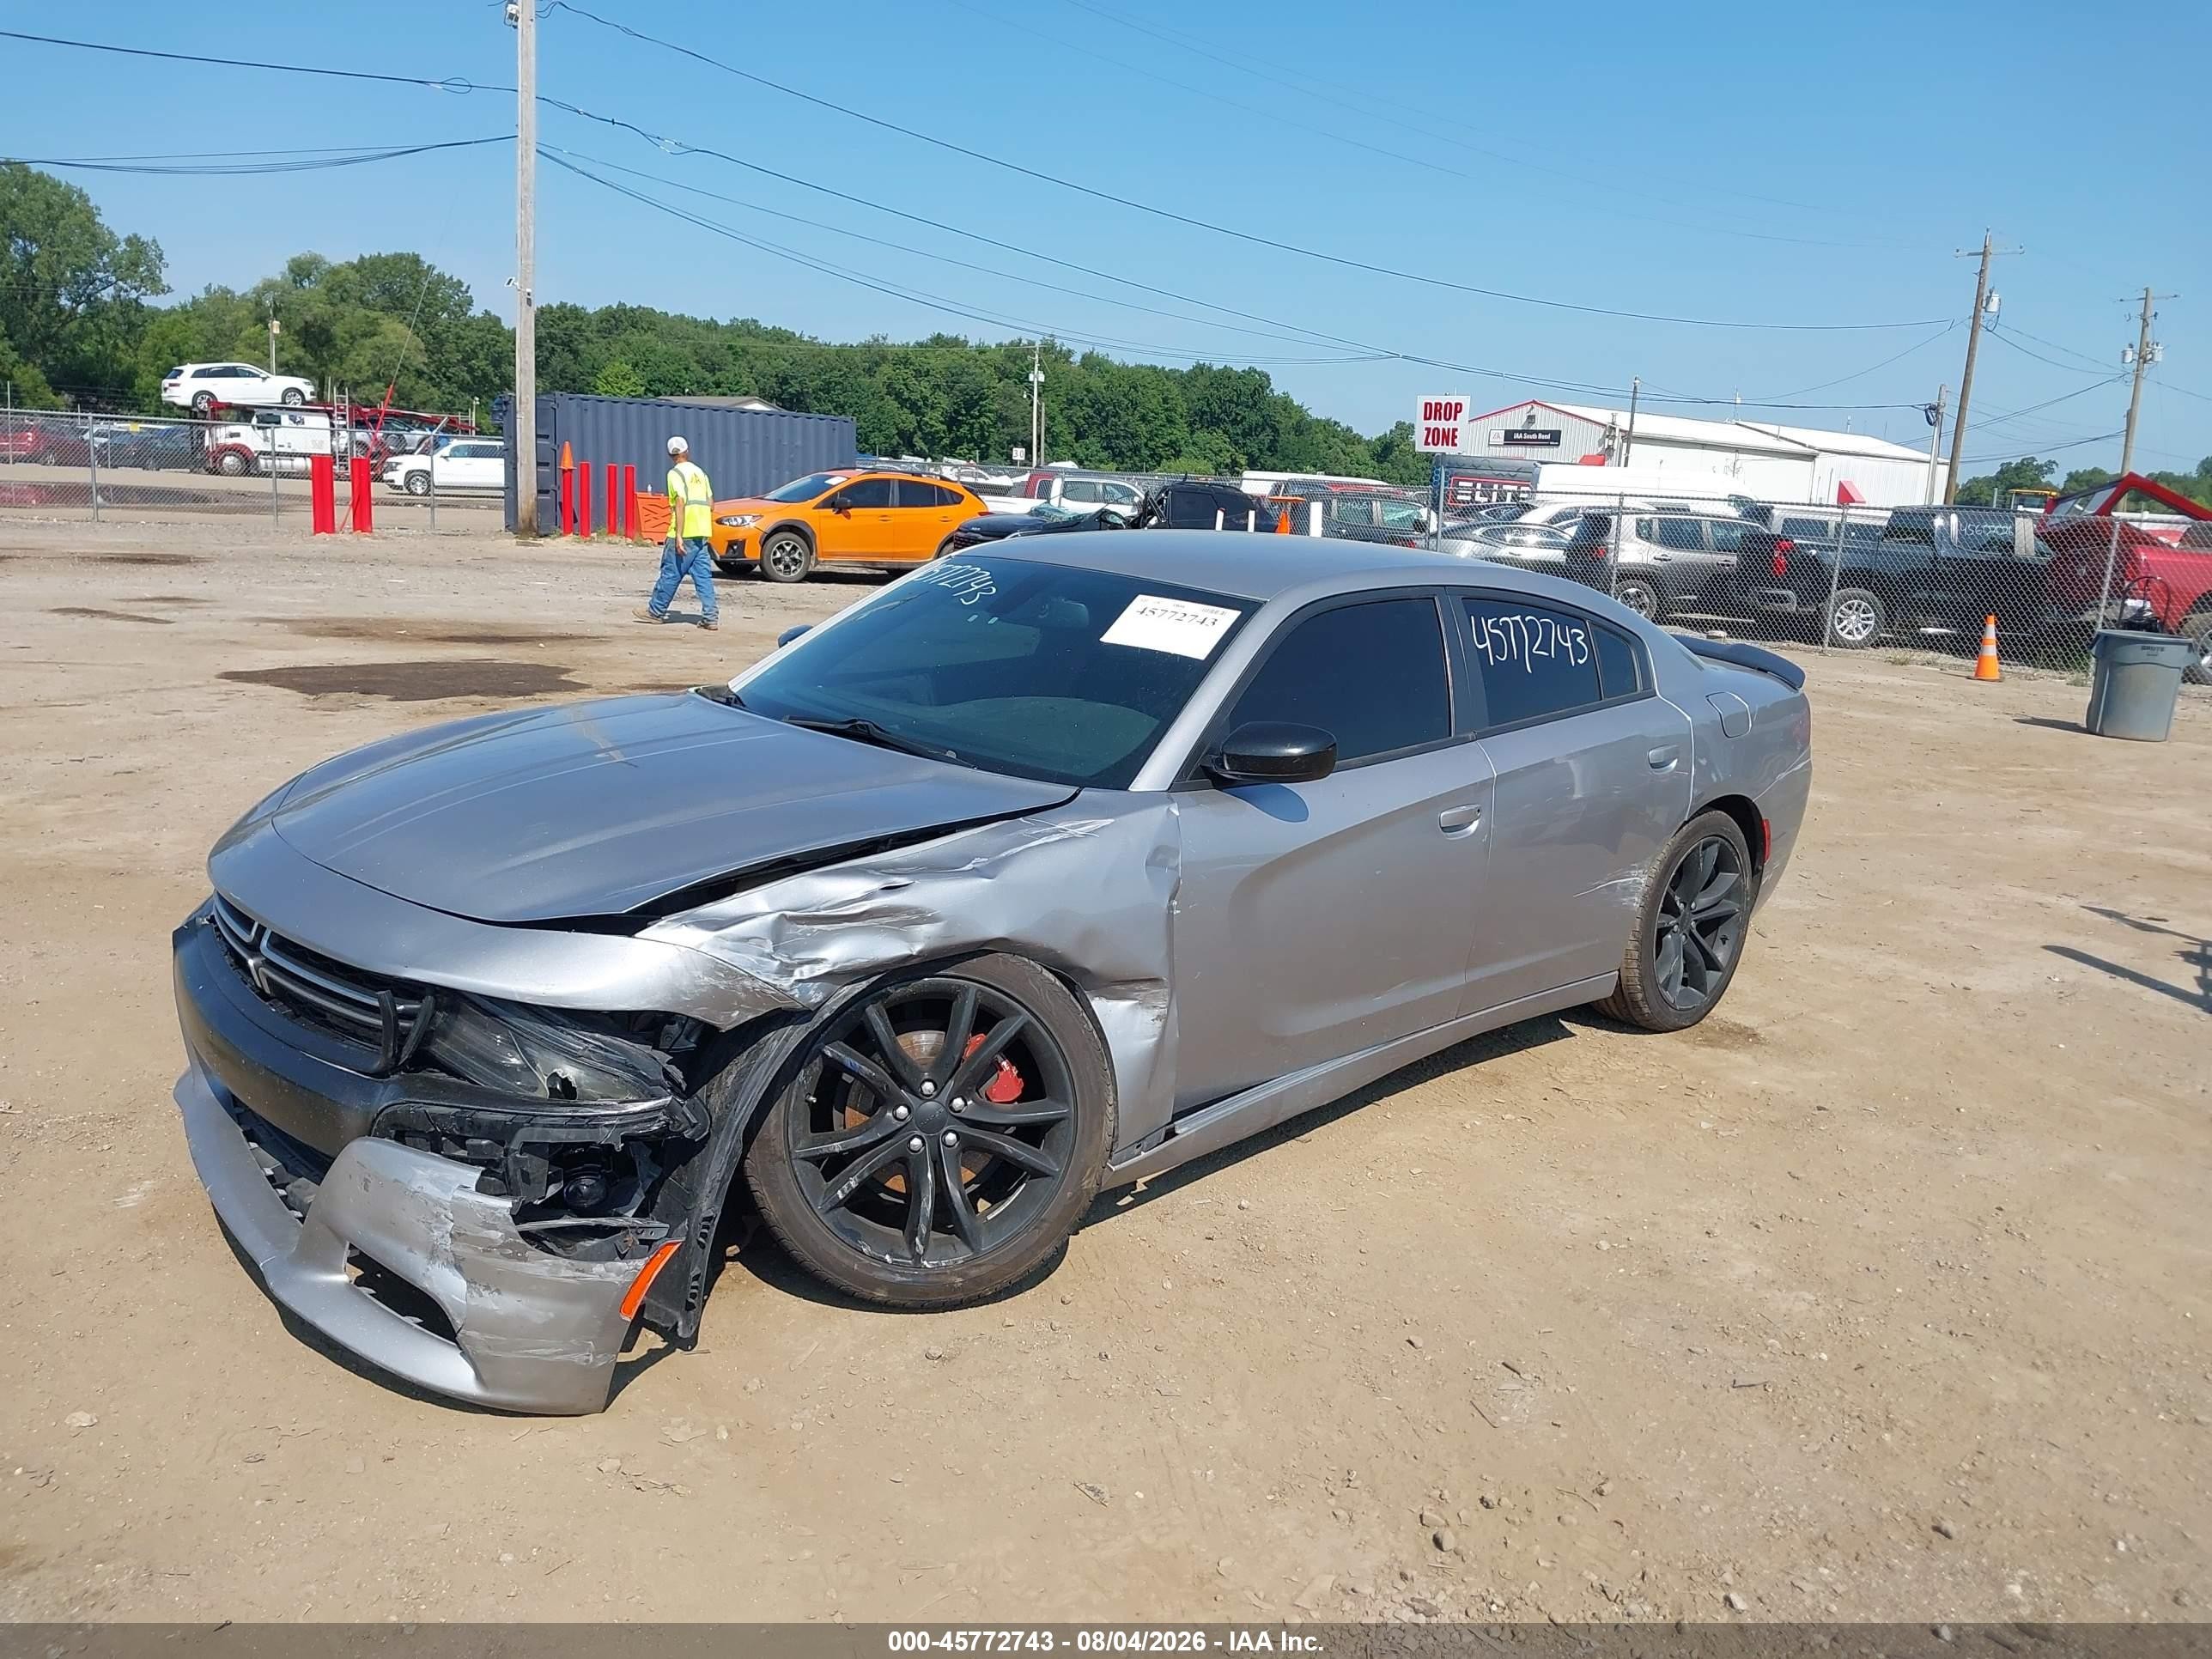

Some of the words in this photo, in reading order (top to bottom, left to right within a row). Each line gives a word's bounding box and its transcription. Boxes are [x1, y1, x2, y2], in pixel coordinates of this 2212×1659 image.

[1423, 402, 1463, 422] DROP
[1424, 427, 1459, 447] ZONE
[1013, 449, 1024, 458] 30
[912, 562, 997, 605] 5772743
[1136, 606, 1219, 628] 45772743
[1471, 615, 1589, 674] 45772743
